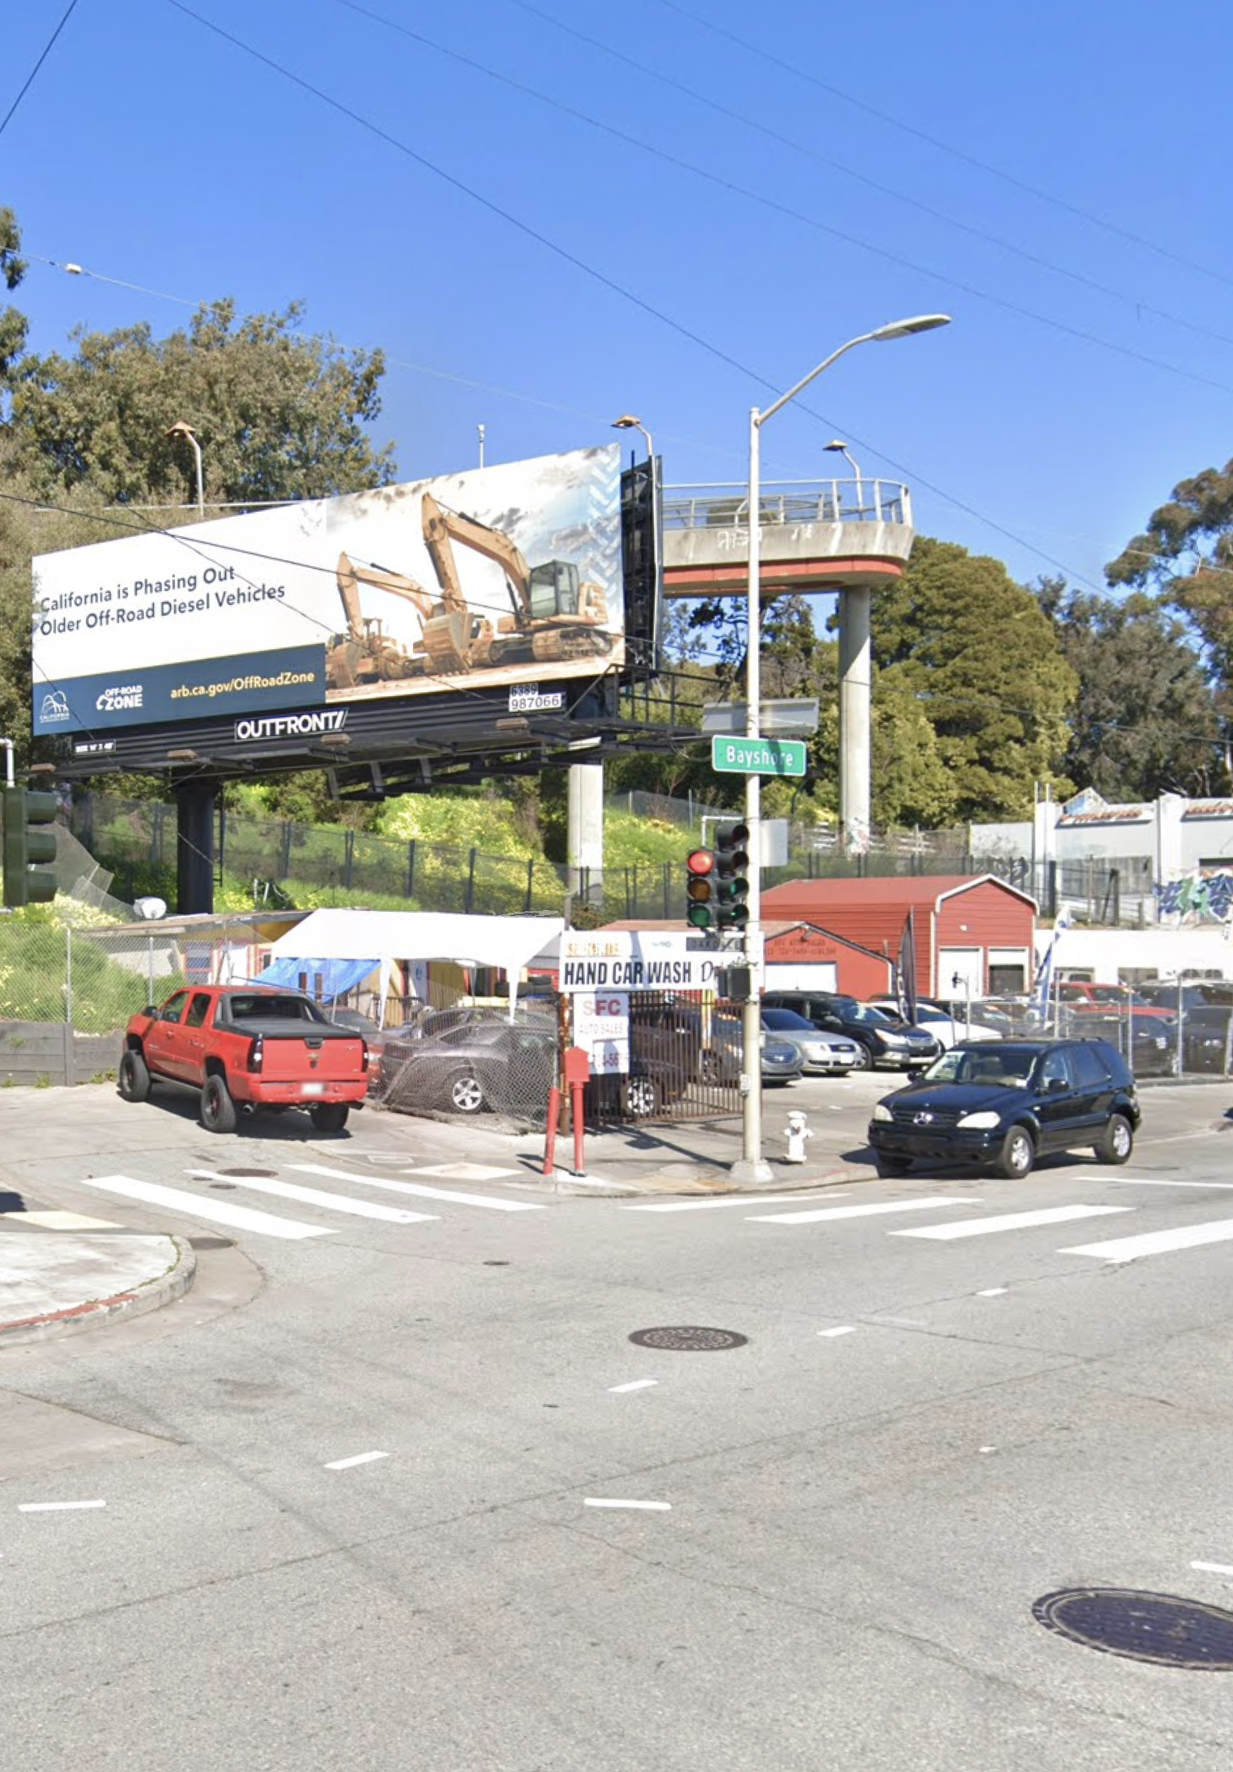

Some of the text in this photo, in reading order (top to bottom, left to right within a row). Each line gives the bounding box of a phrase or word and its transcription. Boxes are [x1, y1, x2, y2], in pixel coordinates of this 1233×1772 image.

[40, 566, 235, 612] California is Phasing Out
[40, 583, 285, 636] Older Off-Road Diesel Vehicles
[105, 685, 143, 697] OFF-ROAD
[170, 671, 315, 699] arb.ca.gov/OffRoadZone
[105, 694, 143, 711] ZONE
[511, 696, 559, 710] 987066
[727, 745, 794, 768] Bayshore
[564, 962, 608, 985] HAND
[612, 962, 644, 984] CAR
[648, 961, 692, 983] WASH
[583, 999, 621, 1017] SFC
